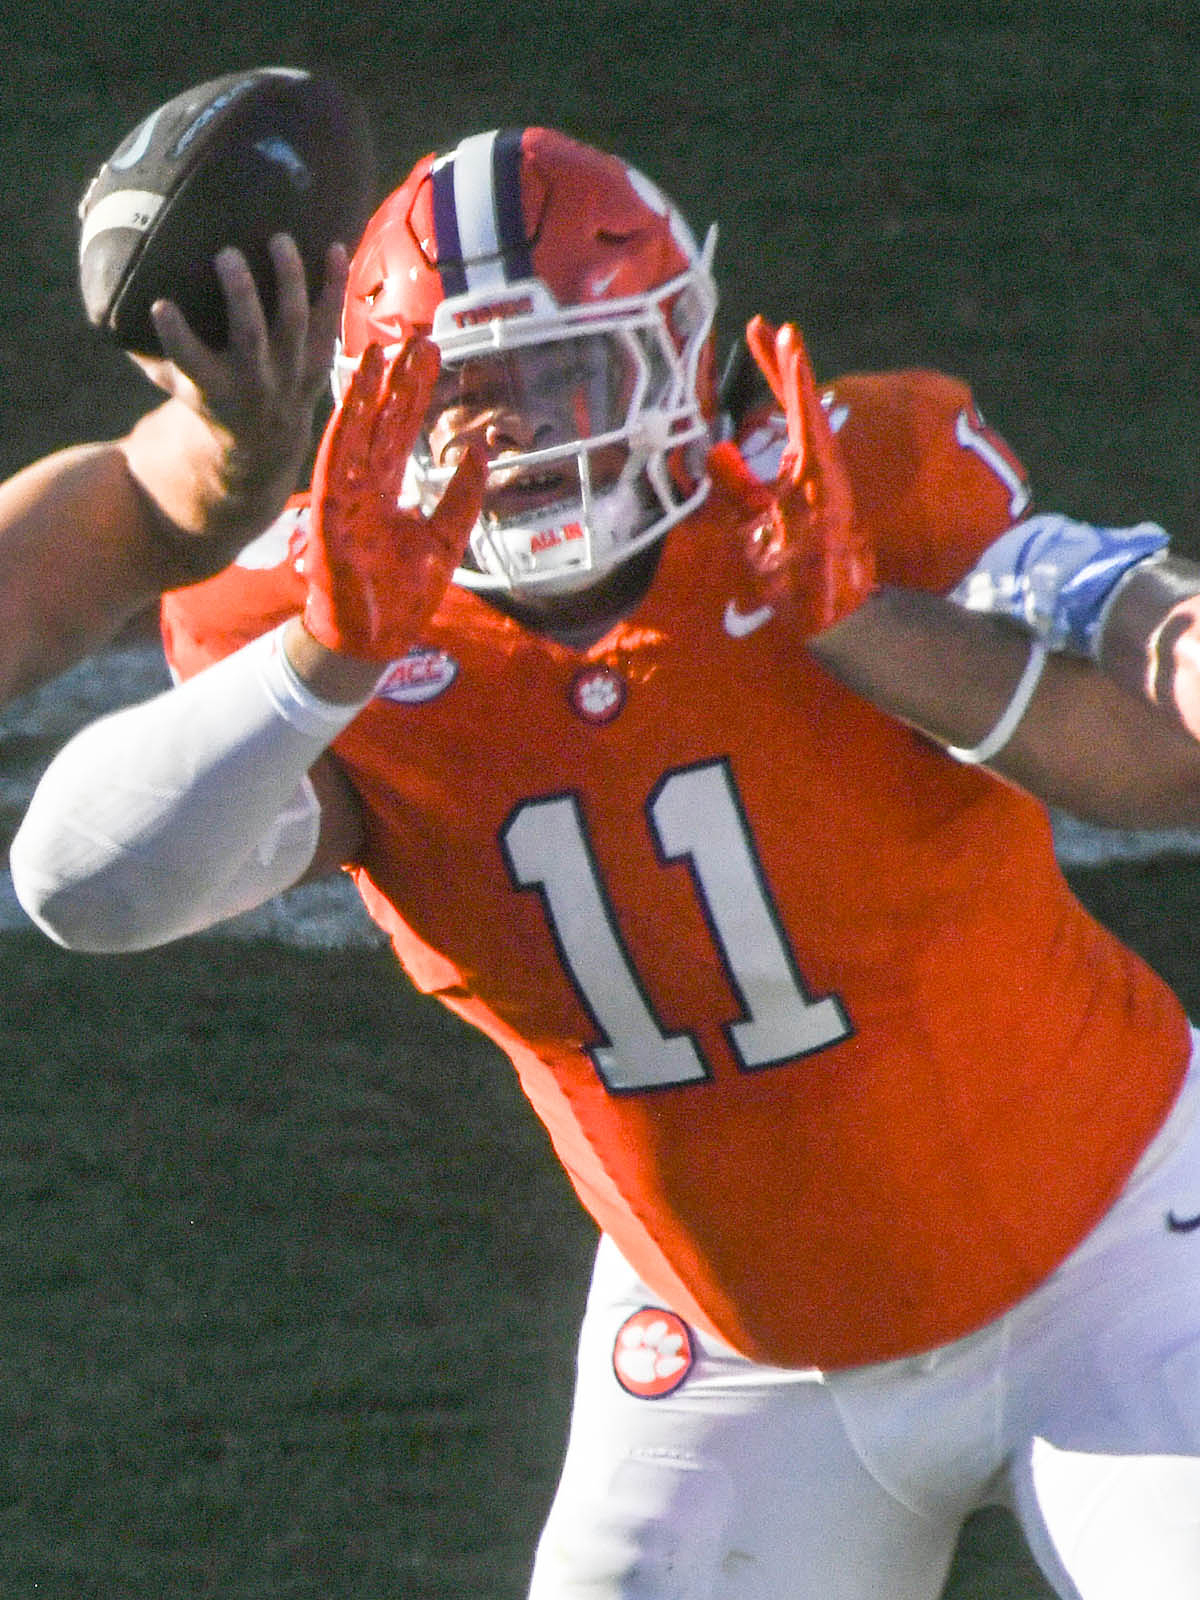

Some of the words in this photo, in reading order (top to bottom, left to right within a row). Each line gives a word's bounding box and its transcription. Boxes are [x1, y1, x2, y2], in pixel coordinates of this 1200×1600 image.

[531, 526, 560, 552] ALL
[563, 521, 584, 541] IN
[502, 758, 853, 1091] 11
